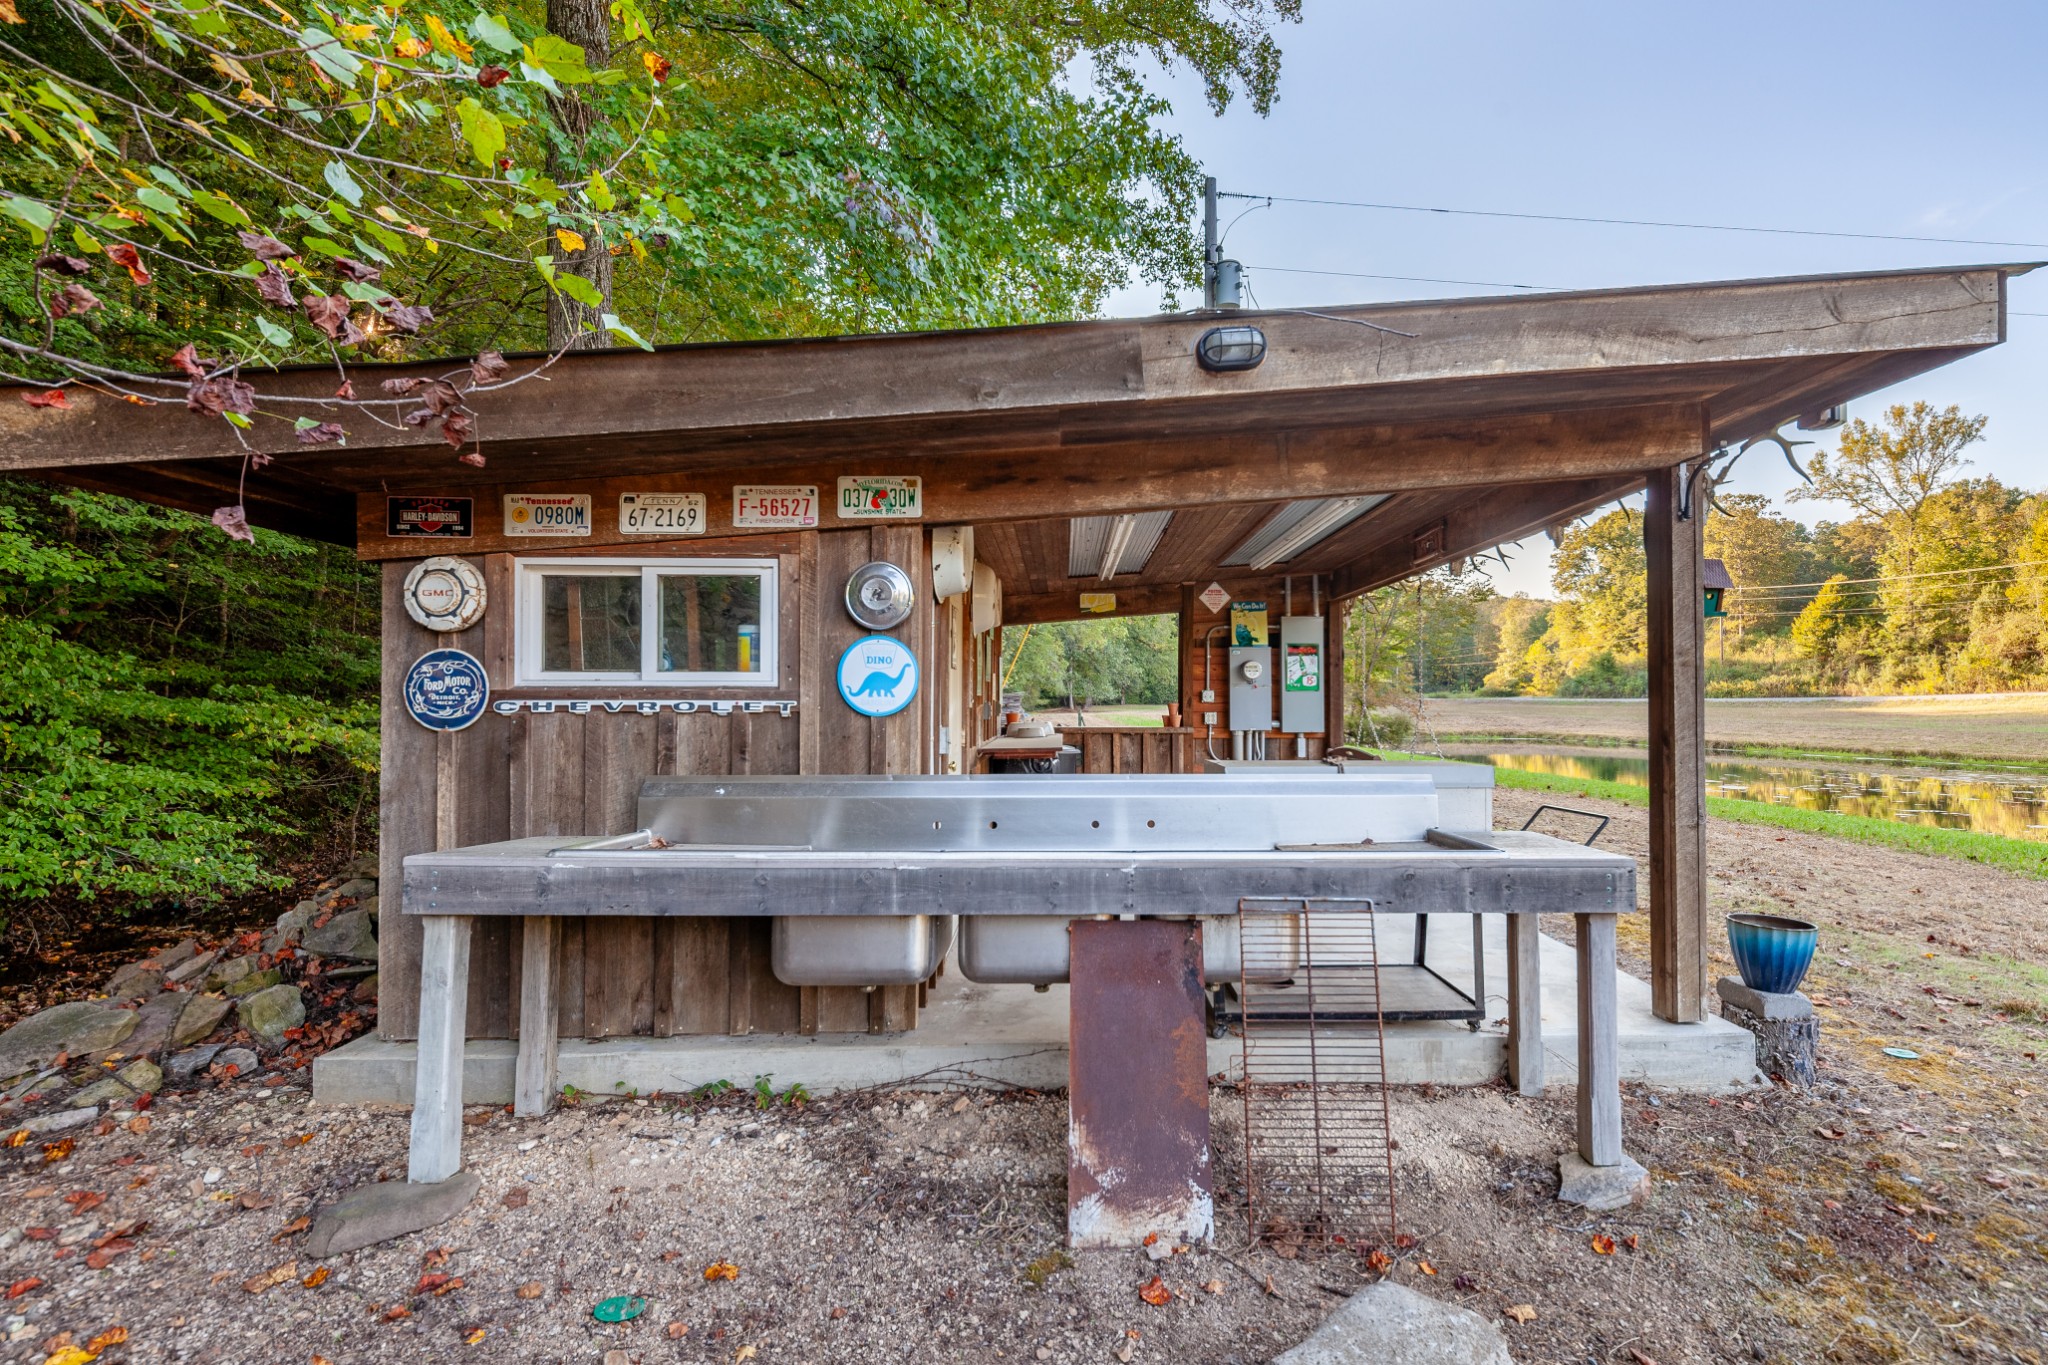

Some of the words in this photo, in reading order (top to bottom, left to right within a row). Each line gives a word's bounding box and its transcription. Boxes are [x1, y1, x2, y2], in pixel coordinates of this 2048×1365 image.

[525, 497, 573, 505] Tennessee
[739, 498, 811, 517] F-56527
[402, 511, 458, 522] HARLEY-DAVIDSON
[422, 589, 454, 597] GMC
[1241, 602, 1252, 610] Can
[866, 656, 893, 665] DINO
[494, 700, 798, 713] CHEVROLET
